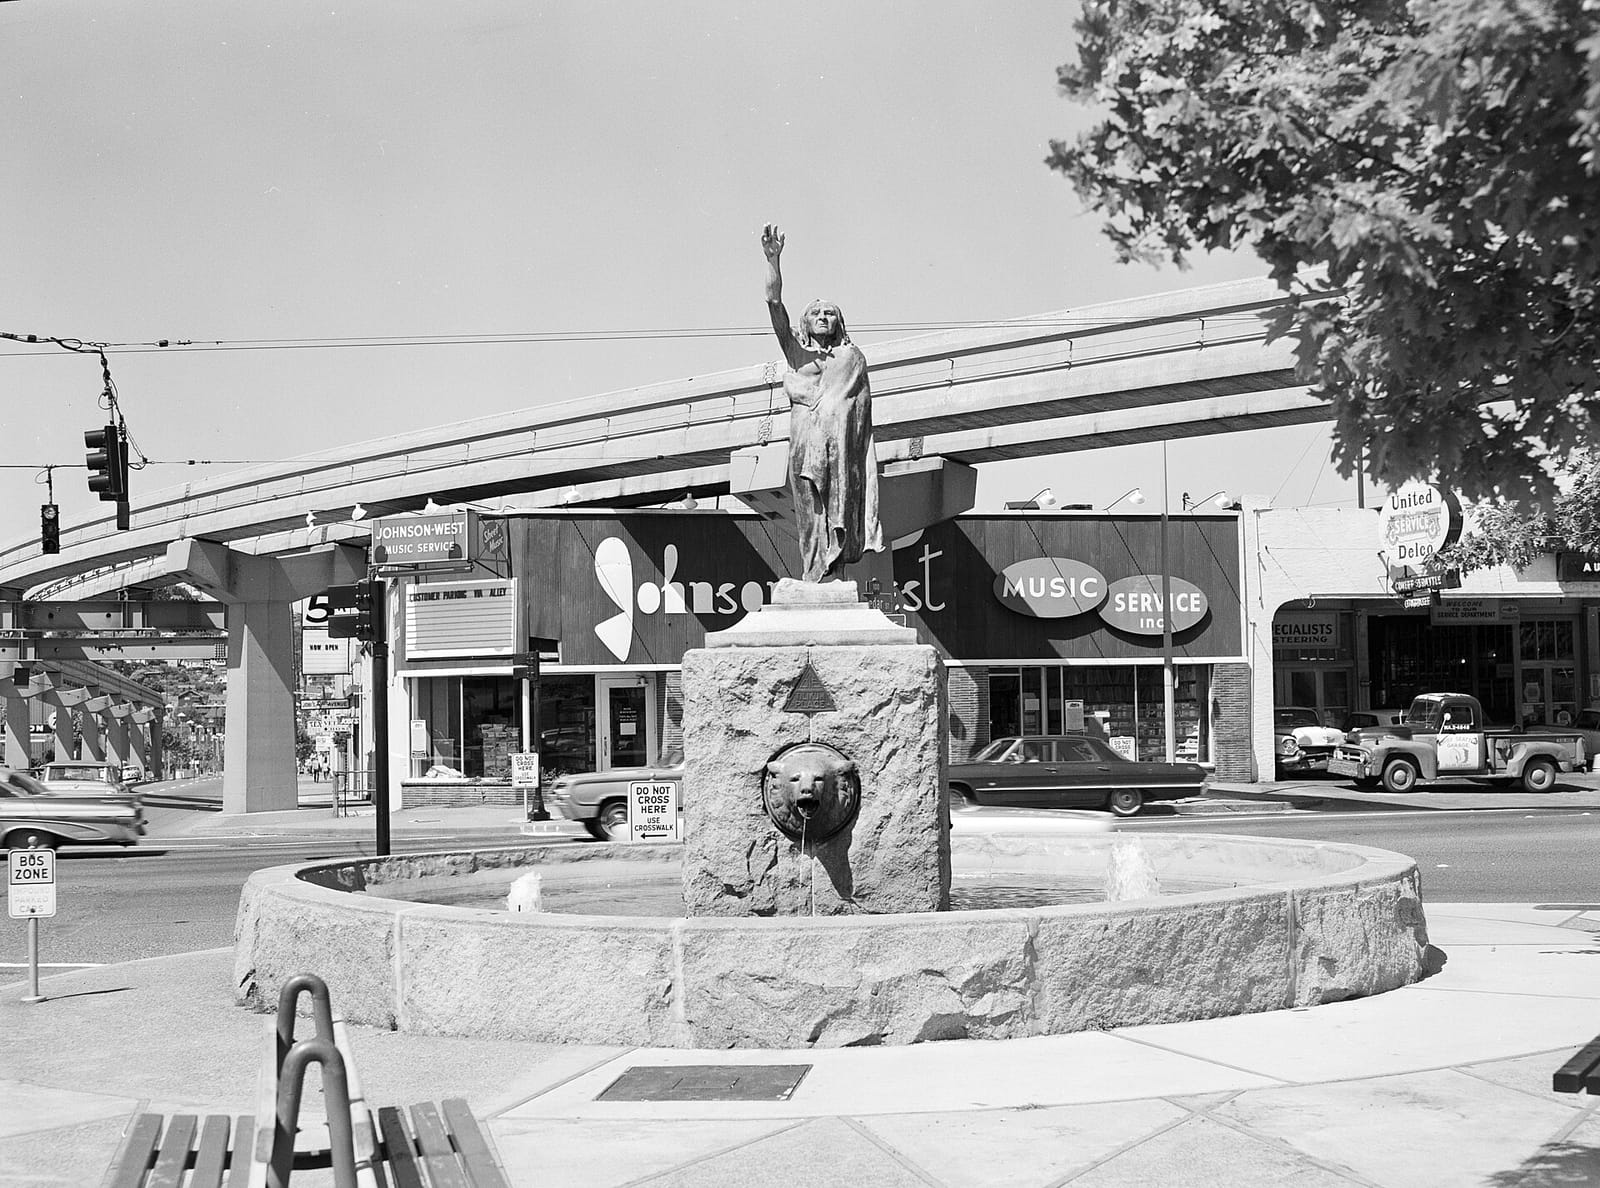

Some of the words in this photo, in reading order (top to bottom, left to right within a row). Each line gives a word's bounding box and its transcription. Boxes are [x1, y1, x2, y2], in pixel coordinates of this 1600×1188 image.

[1392, 489, 1432, 510] United
[384, 544, 414, 555] MUSIC
[417, 541, 455, 552] SERVICE
[1398, 542, 1434, 560] Delco
[1002, 577, 1099, 599] MUSIC
[1114, 593, 1201, 612] SERVICE
[1274, 623, 1333, 635] ECIALISTS
[636, 786, 649, 795] DO
[653, 785, 671, 795] NOT
[638, 796, 670, 804] CROSS
[641, 805, 667, 814] HERE
[15, 868, 49, 880] ZONE
